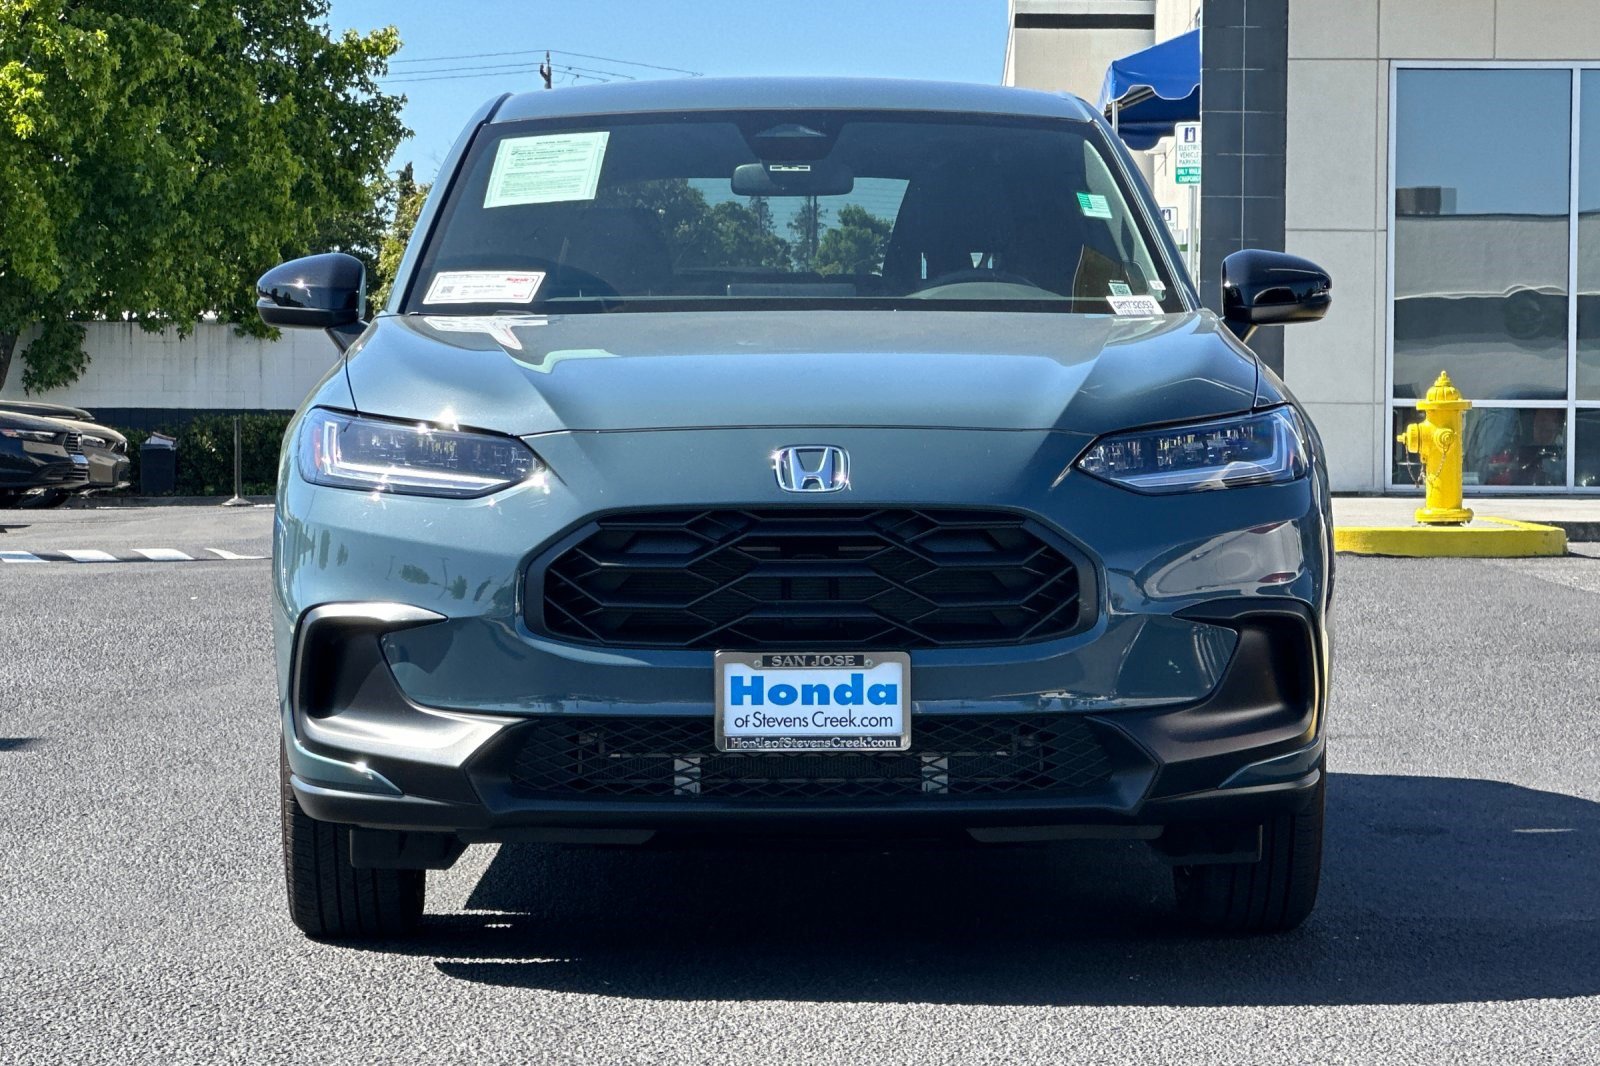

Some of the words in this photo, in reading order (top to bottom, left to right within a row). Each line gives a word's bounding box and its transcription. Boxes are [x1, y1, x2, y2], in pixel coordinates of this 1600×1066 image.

[771, 655, 806, 667] SAN
[810, 655, 856, 667] JOSE
[730, 673, 898, 706] Honda
[734, 714, 751, 728] of
[752, 711, 809, 728] Stevens
[811, 708, 893, 728] Creek.com
